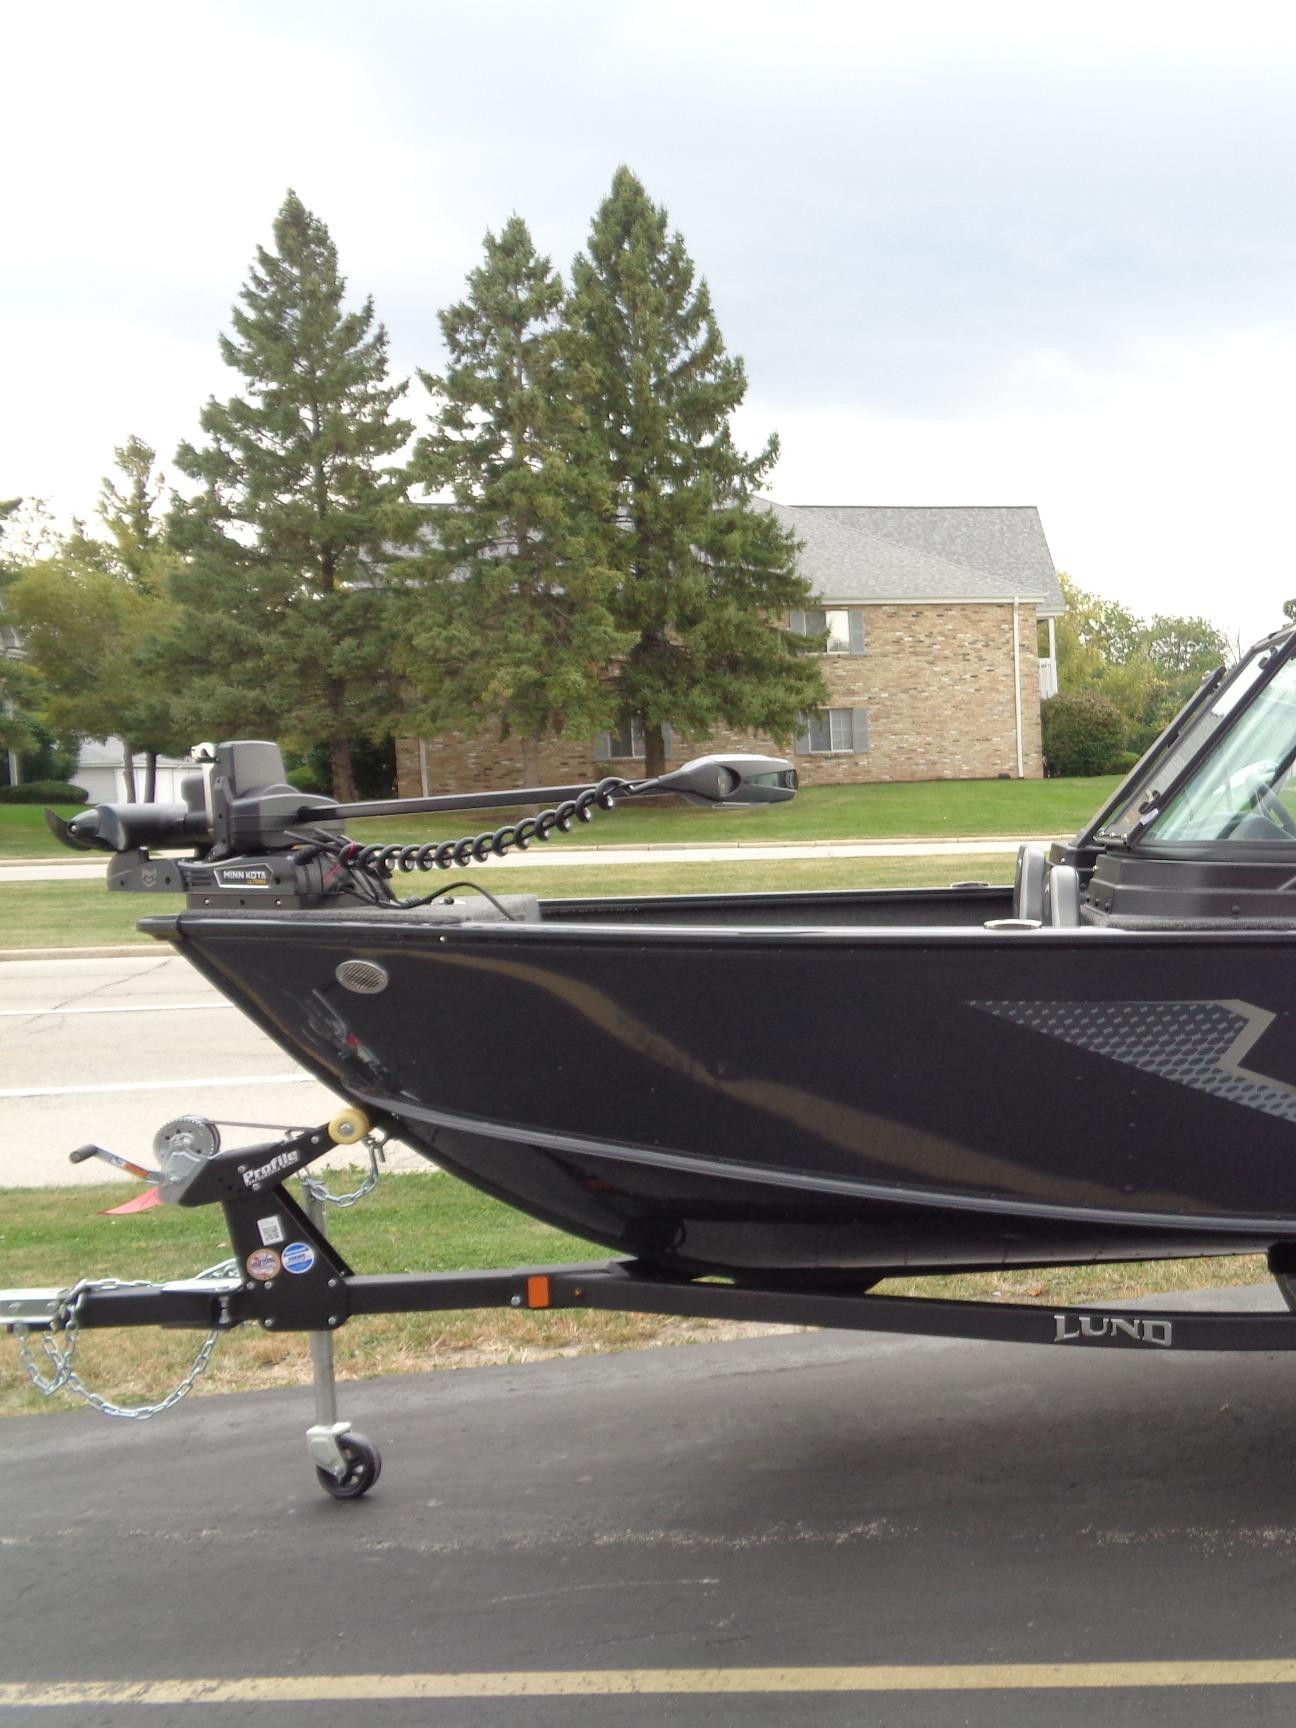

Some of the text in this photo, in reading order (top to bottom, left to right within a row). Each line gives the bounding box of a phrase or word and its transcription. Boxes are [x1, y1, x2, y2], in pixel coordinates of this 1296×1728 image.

[223, 870, 267, 879] MINN KOTA
[242, 1150, 299, 1186] Profile
[1053, 1315, 1172, 1347] LUND
